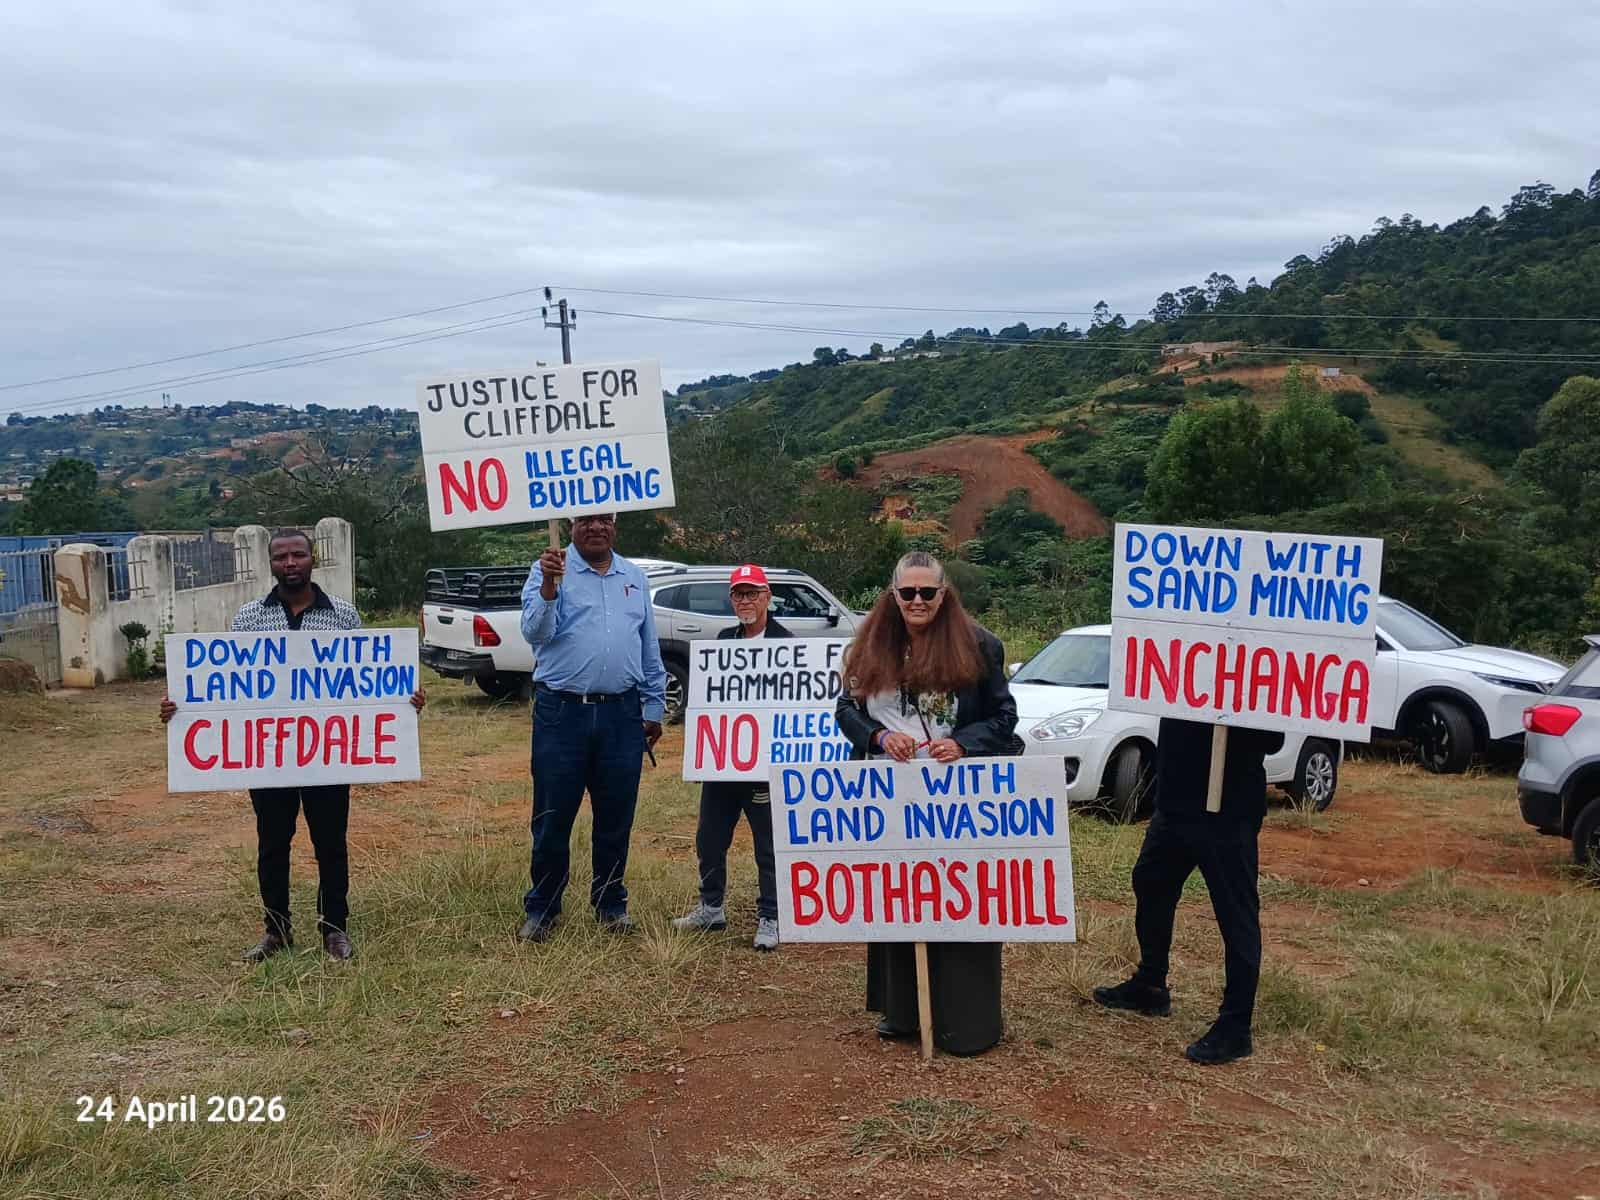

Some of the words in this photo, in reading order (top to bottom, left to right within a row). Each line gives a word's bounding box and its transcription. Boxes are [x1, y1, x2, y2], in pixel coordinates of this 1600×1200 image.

[427, 374, 559, 412] JUSTICE
[583, 369, 638, 398] FOR
[463, 400, 615, 438] CLIFFDALE
[525, 442, 632, 479] ILLEGAL
[439, 457, 508, 515] NO
[528, 468, 660, 509] BUILDING
[1125, 531, 1242, 571] DOWN
[1265, 540, 1361, 578] WITH
[1127, 567, 1237, 613] SAND
[1249, 573, 1371, 625] MINING
[186, 637, 286, 668] DOWN
[311, 635, 391, 665] WITH
[698, 645, 807, 672] JUSTICE
[186, 669, 275, 703] LAND
[290, 665, 415, 700] INVASION
[1124, 636, 1370, 724] INCHANGA
[184, 713, 397, 770] CLIFFDALE
[695, 713, 760, 772] NO
[782, 766, 895, 805] DOWN
[922, 762, 1016, 796] WITH
[788, 805, 885, 844] LAND
[904, 798, 1054, 840] INVASION
